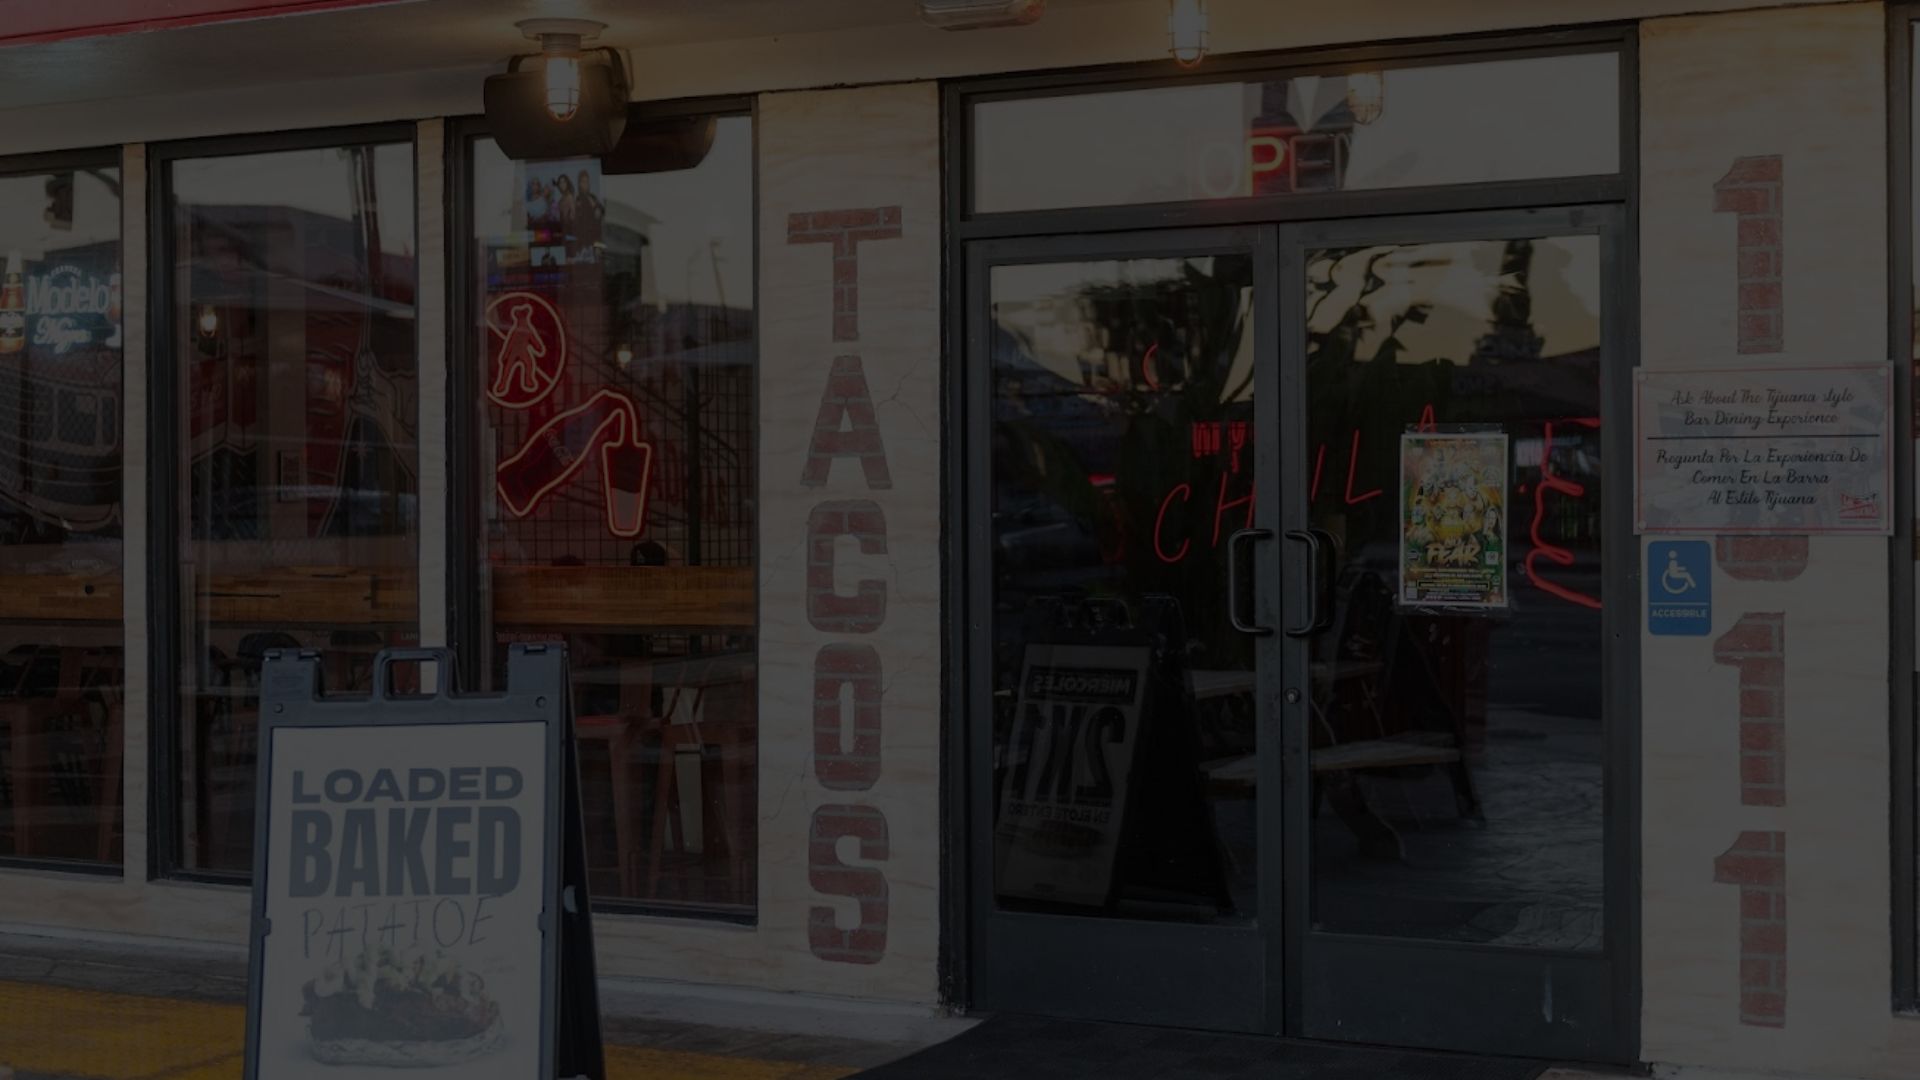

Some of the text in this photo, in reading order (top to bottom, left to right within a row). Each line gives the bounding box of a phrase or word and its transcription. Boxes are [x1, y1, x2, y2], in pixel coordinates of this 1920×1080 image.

[26, 274, 110, 315] Modelo
[1671, 390, 1695, 406] Ask
[1699, 389, 1738, 405] About
[1740, 388, 1762, 403] The
[1765, 387, 1817, 408] Tijuana
[1684, 408, 1839, 430] Bar Dining Experience
[1655, 446, 1869, 469] Pregunta Por La Experiencia De
[1691, 468, 1832, 485] Comer En La Barra
[1707, 489, 1723, 505] Al
[1726, 488, 1761, 506] Estilo
[1764, 488, 1819, 510] Tijuana
[786, 205, 902, 964] TACOS
[1650, 607, 1708, 619] ACCESSIBLE
[292, 766, 524, 804] LOADED
[288, 805, 522, 898] BAKED
[302, 894, 503, 961] PATATOE
